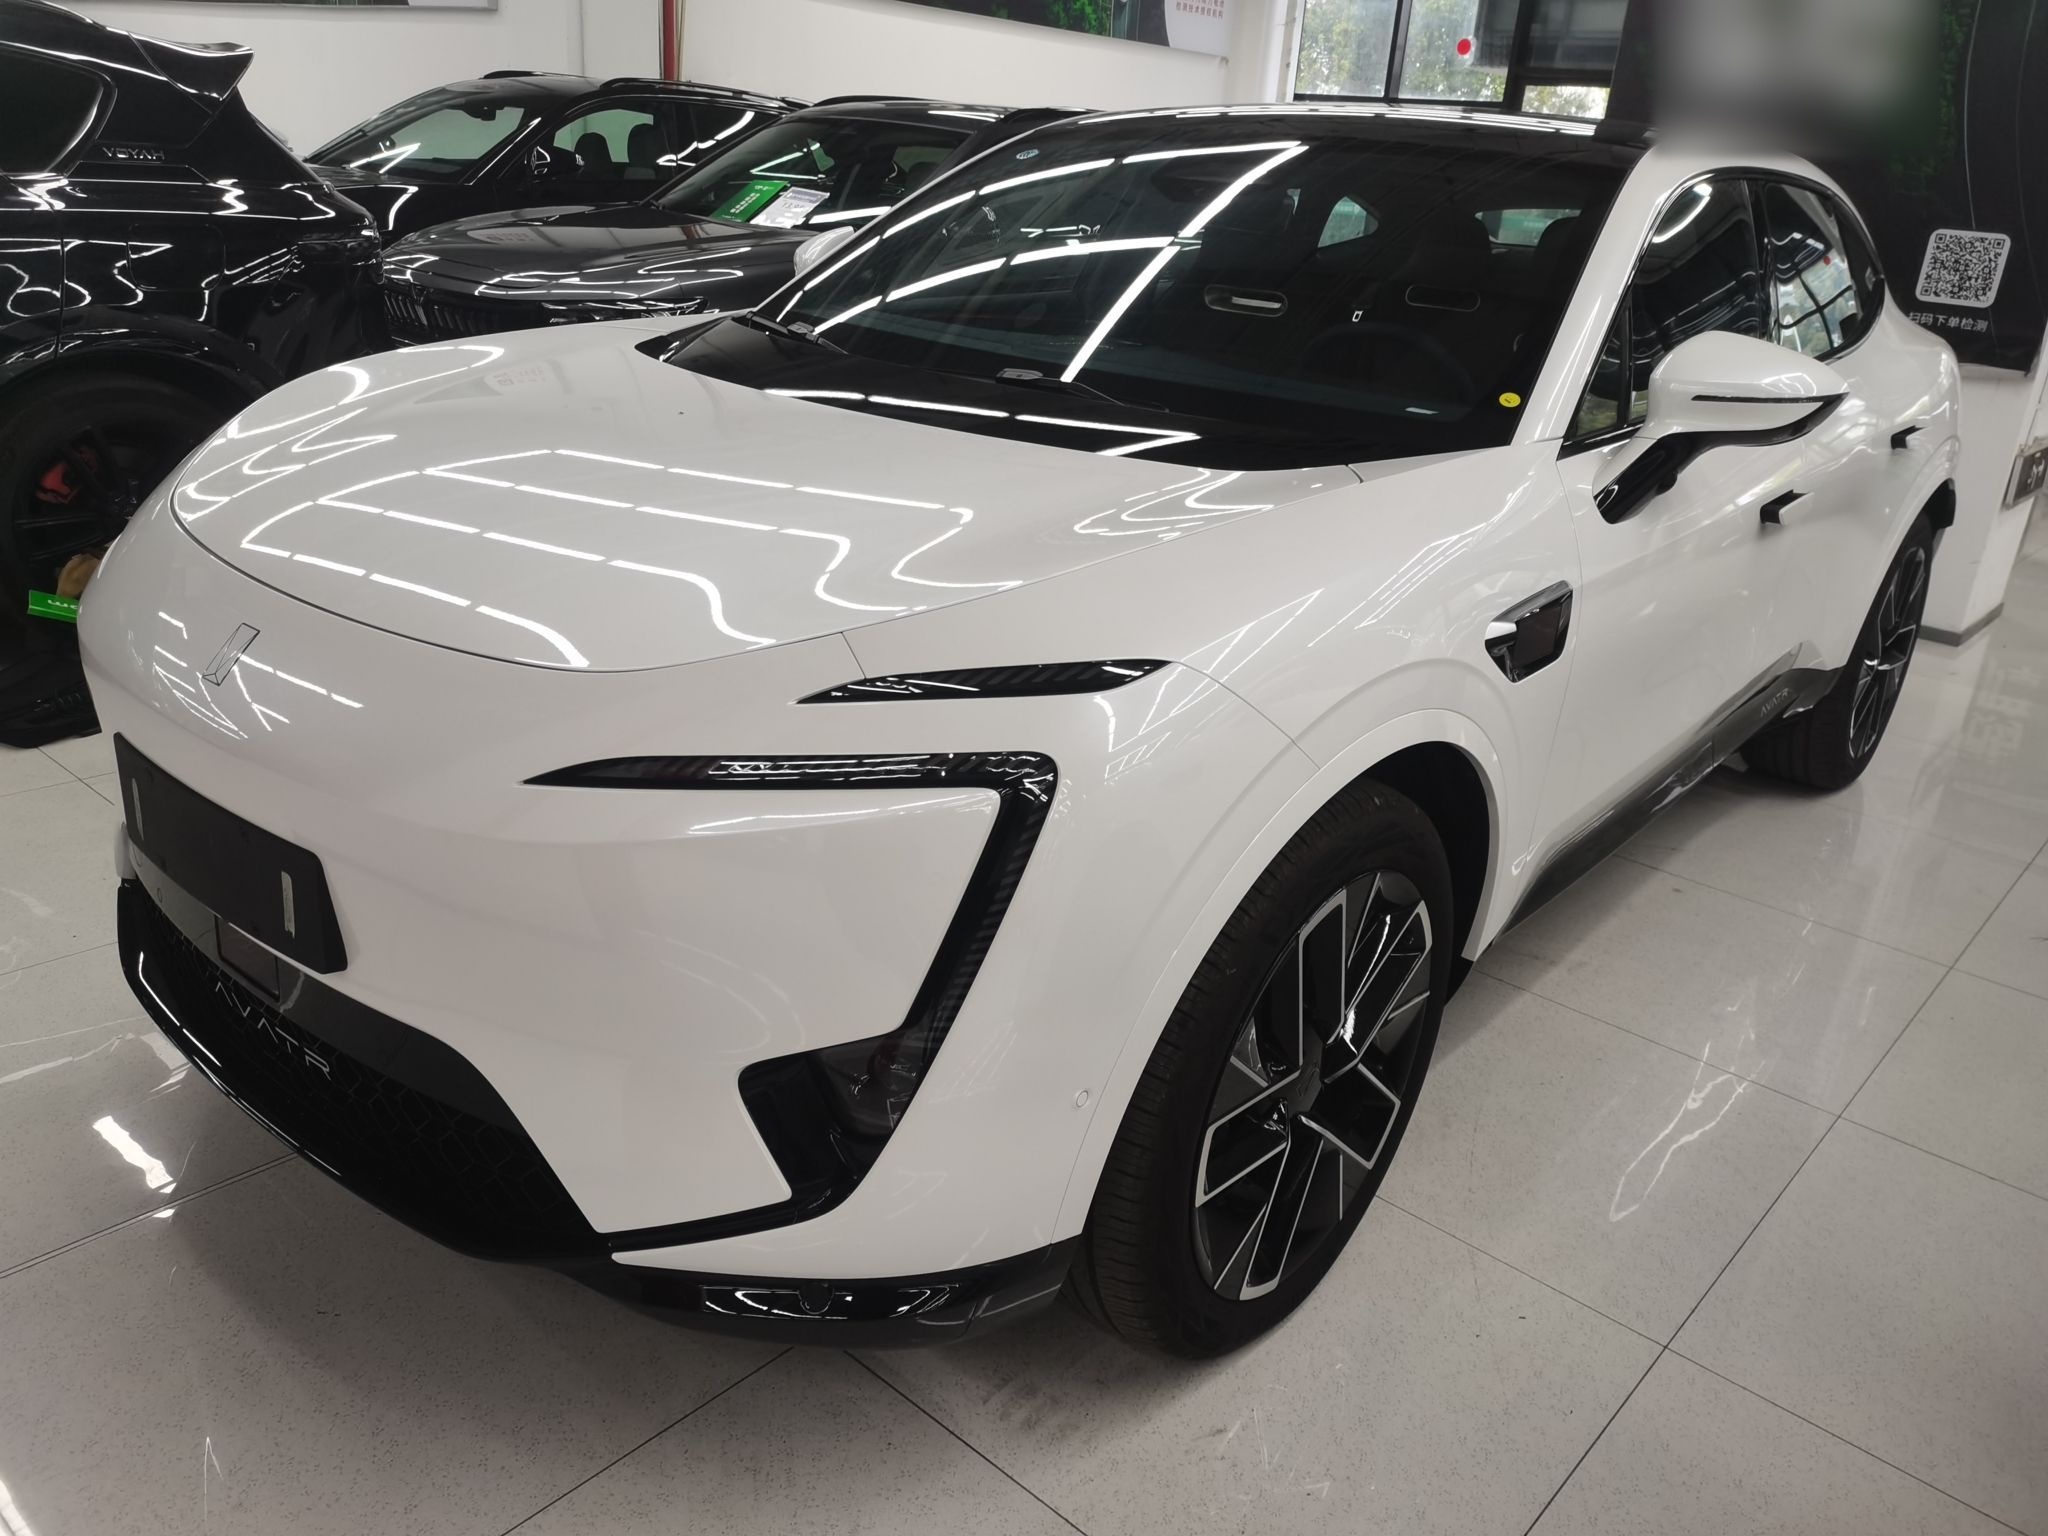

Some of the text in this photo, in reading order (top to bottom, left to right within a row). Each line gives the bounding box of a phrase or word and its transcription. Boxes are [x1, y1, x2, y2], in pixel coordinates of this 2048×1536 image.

[102, 147, 165, 160] VOYAH
[1908, 312, 1988, 332] 扫码下单检测
[1760, 687, 1789, 718] AVATR
[215, 981, 332, 1081] AVATR
